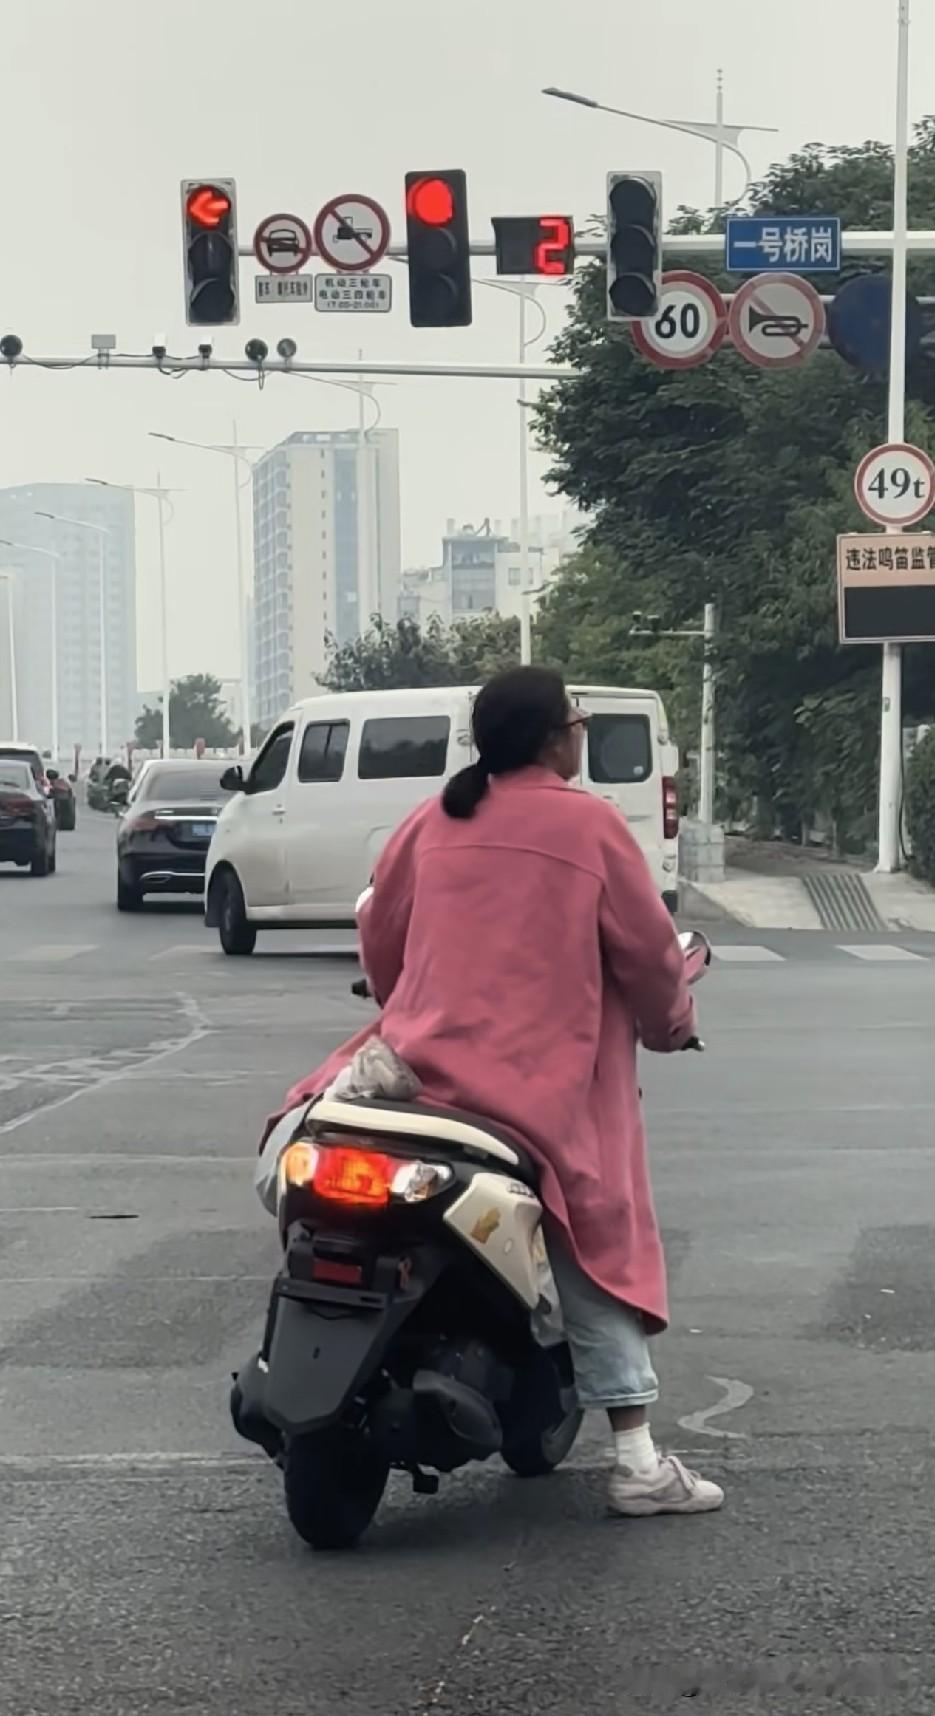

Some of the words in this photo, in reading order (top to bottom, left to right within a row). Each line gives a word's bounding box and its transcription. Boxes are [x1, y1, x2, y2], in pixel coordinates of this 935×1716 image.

[534, 216, 570, 275] 2
[733, 226, 833, 263] 一号桥岗
[655, 304, 700, 339] 60
[867, 467, 925, 499] 49t
